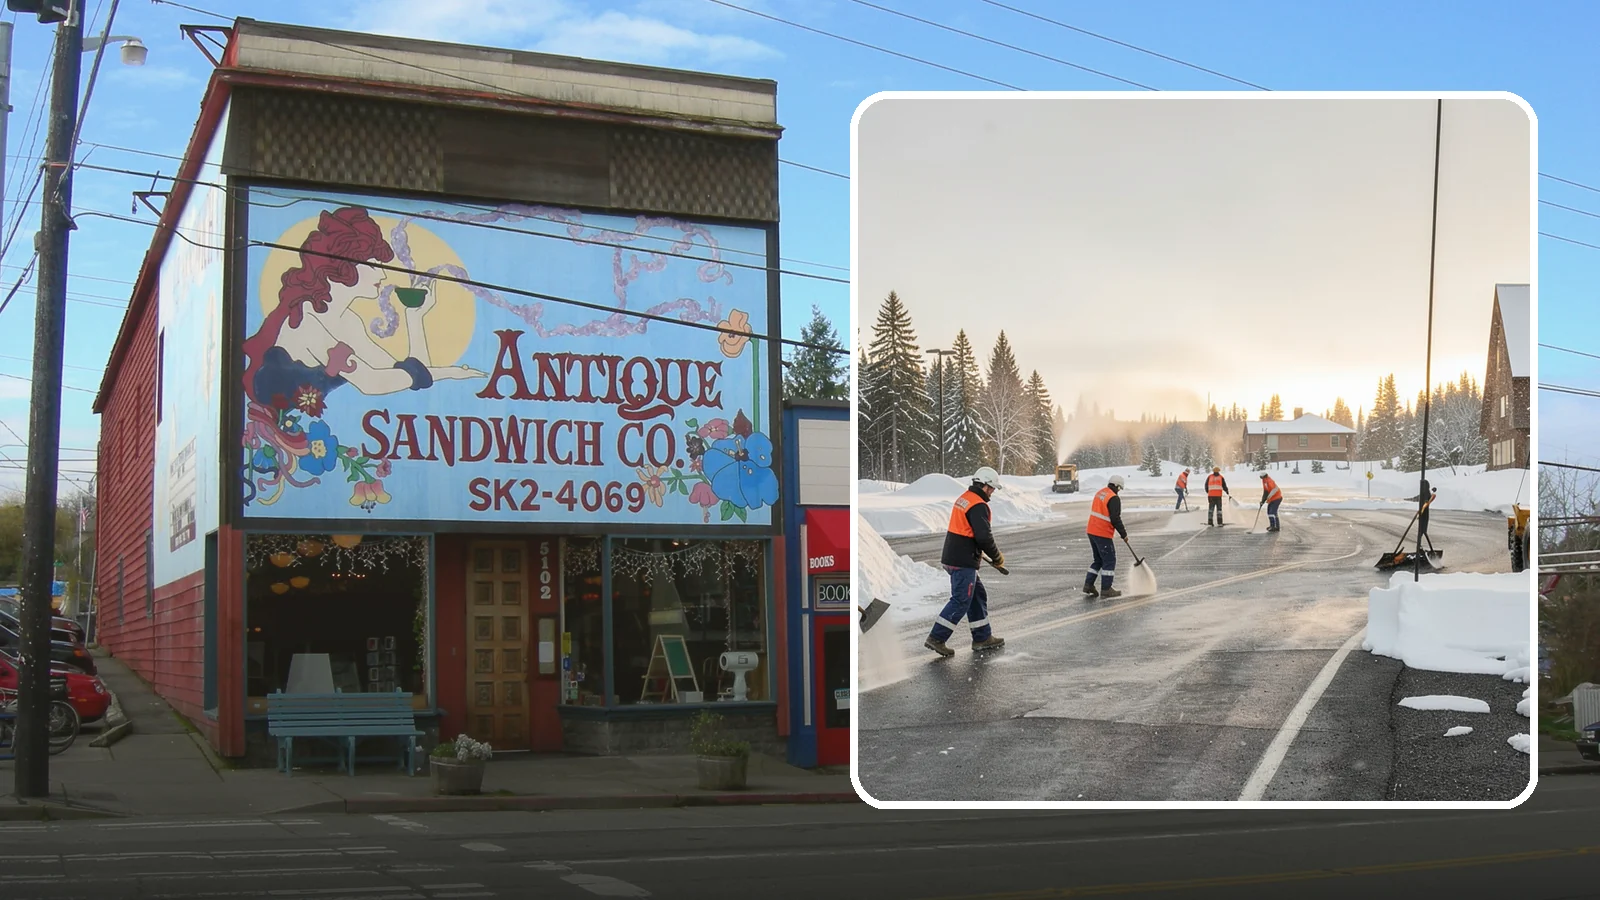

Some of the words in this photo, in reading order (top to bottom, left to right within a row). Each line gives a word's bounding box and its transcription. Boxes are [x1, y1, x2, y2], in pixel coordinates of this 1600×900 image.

[475, 328, 724, 421] ANTIQUE
[361, 408, 605, 467] SANDWICH
[616, 422, 686, 469] CO.
[468, 477, 646, 513] SK2-4069
[539, 541, 552, 600] 5102
[809, 555, 835, 569] BOOKS
